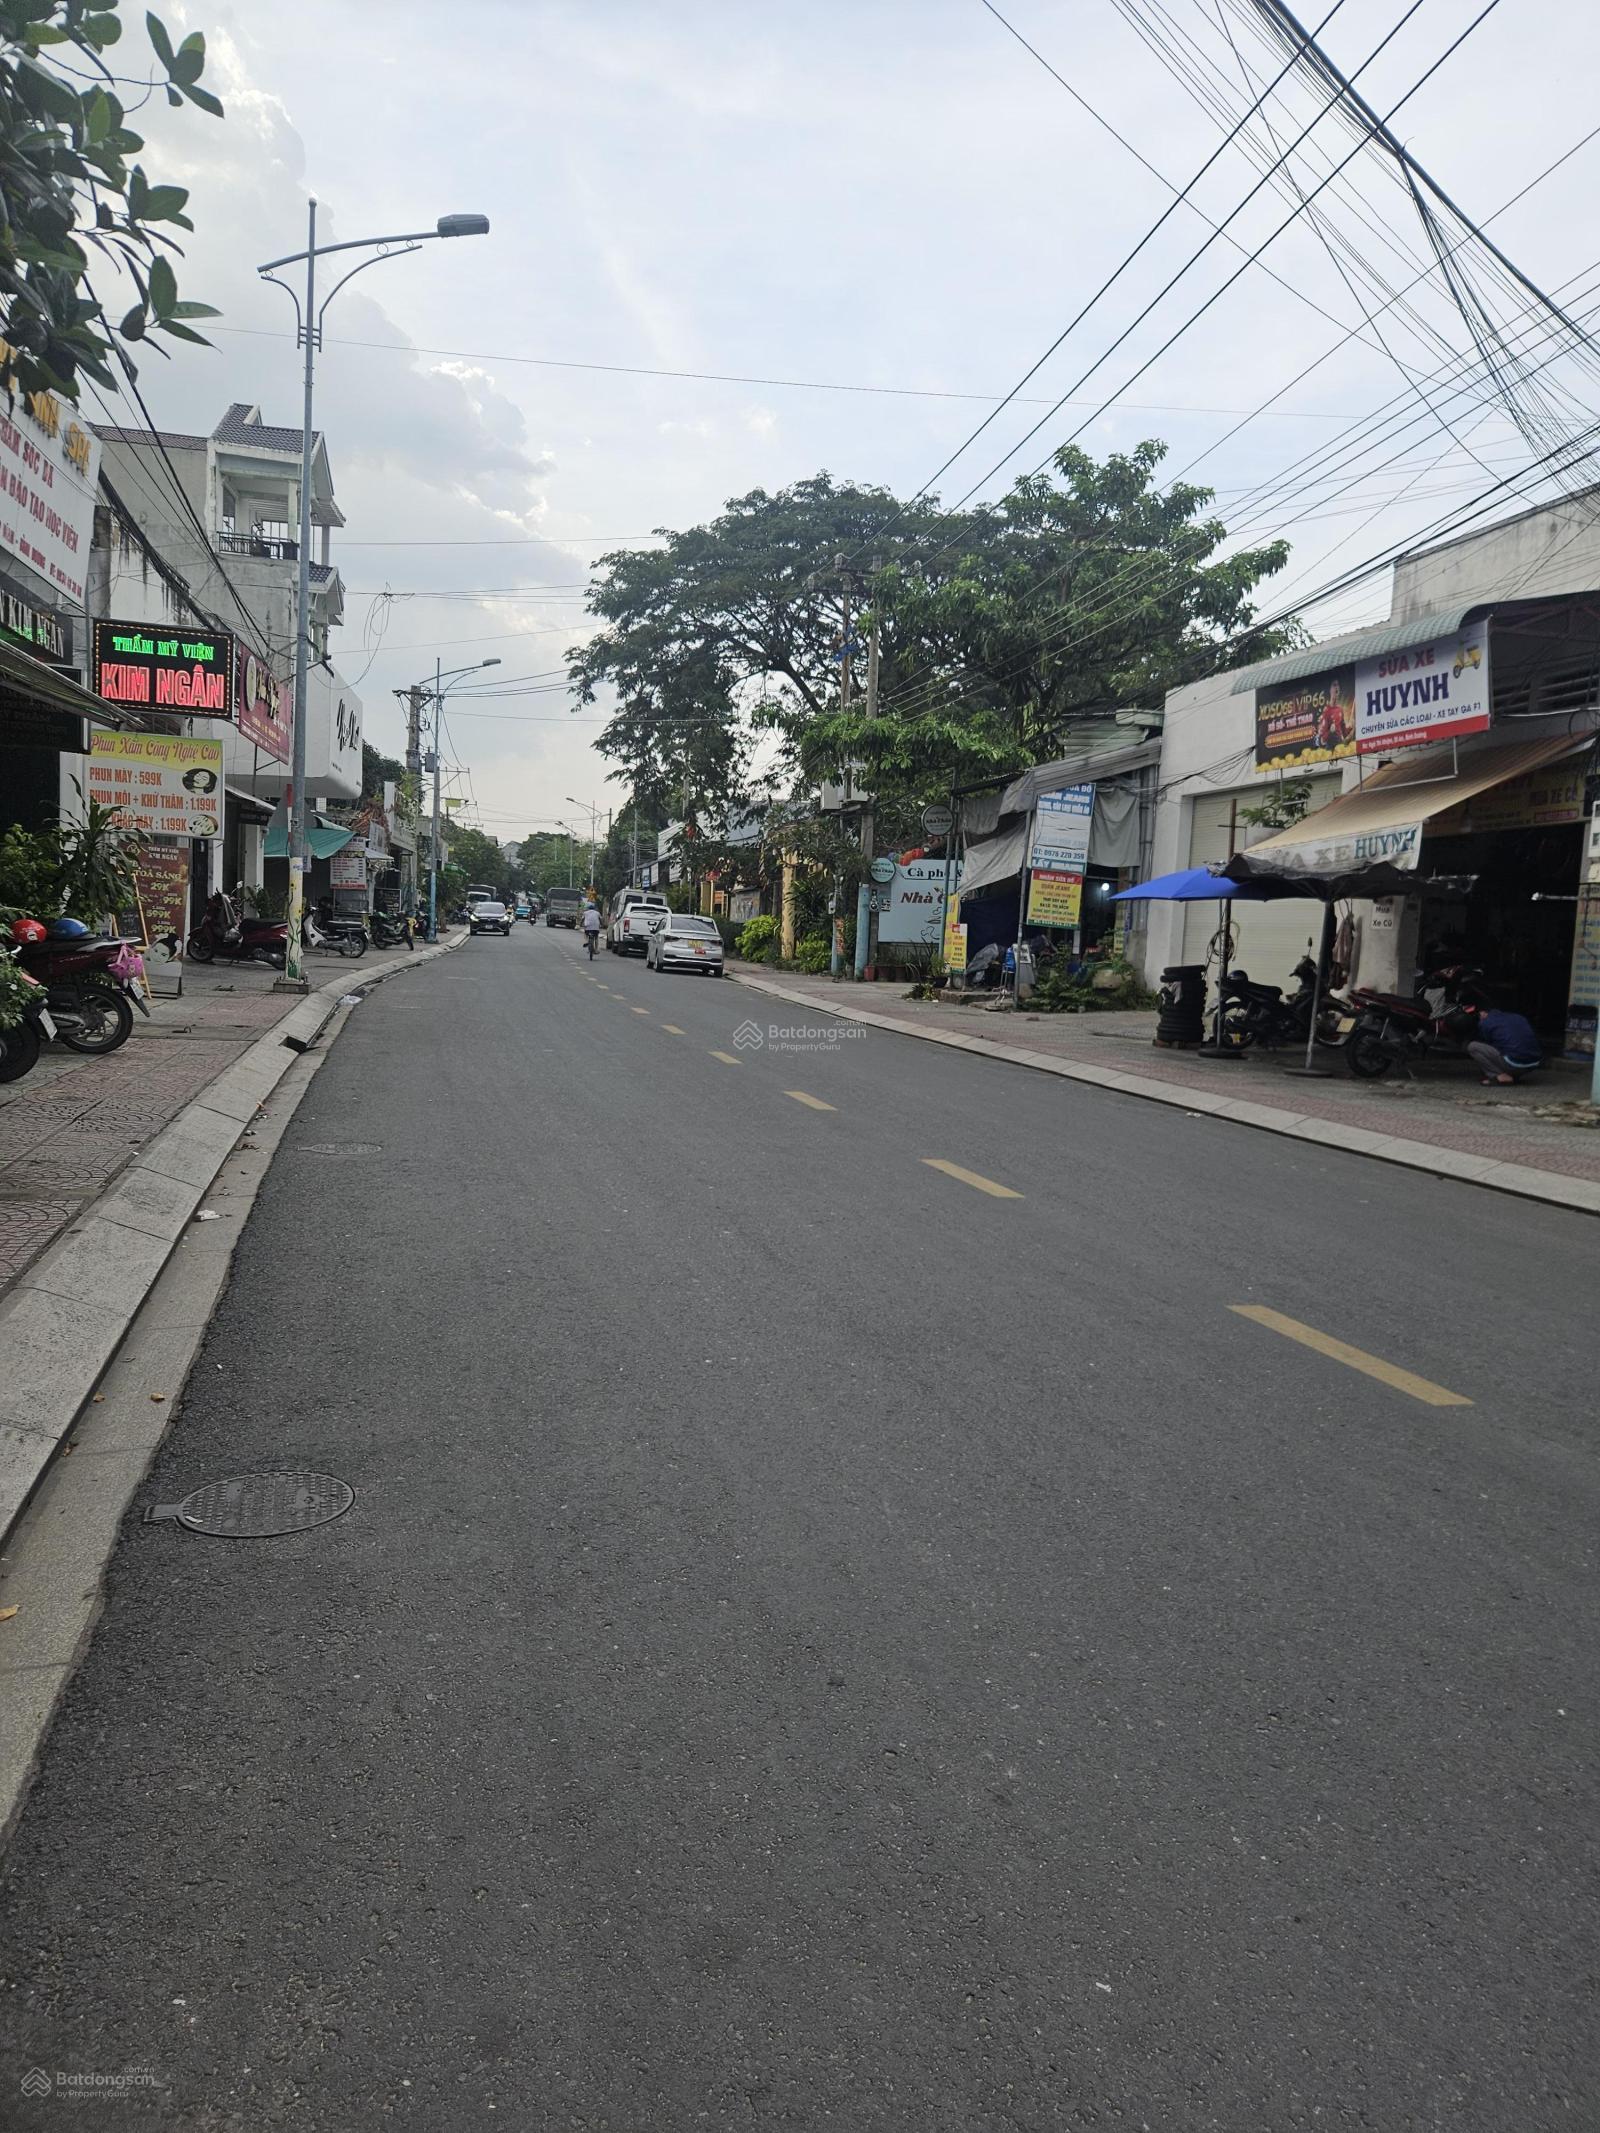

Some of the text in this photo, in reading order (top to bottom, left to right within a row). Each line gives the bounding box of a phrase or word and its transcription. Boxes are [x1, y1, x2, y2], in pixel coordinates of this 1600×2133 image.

[112, 633, 214, 661] THẨM MỸ VIỆN
[1414, 647, 1435, 669] XE
[101, 662, 150, 703] KIM
[156, 664, 225, 709] NGÂN
[1366, 672, 1449, 717] HUYNH
[1400, 713, 1415, 726] CÁC
[91, 735, 115, 753] Phun
[146, 740, 171, 761] Công
[172, 741, 199, 763] Nghệ
[200, 743, 220, 760] Cao
[90, 767, 112, 782] PHUN
[139, 771, 162, 786] 599K
[190, 798, 217, 812] 1.199K
[161, 817, 187, 832] 1.199K
[1354, 829, 1417, 859] HUYNH
[907, 868, 924, 877] Cà
[928, 869, 947, 880] ph
[901, 892, 933, 904] Nhà
